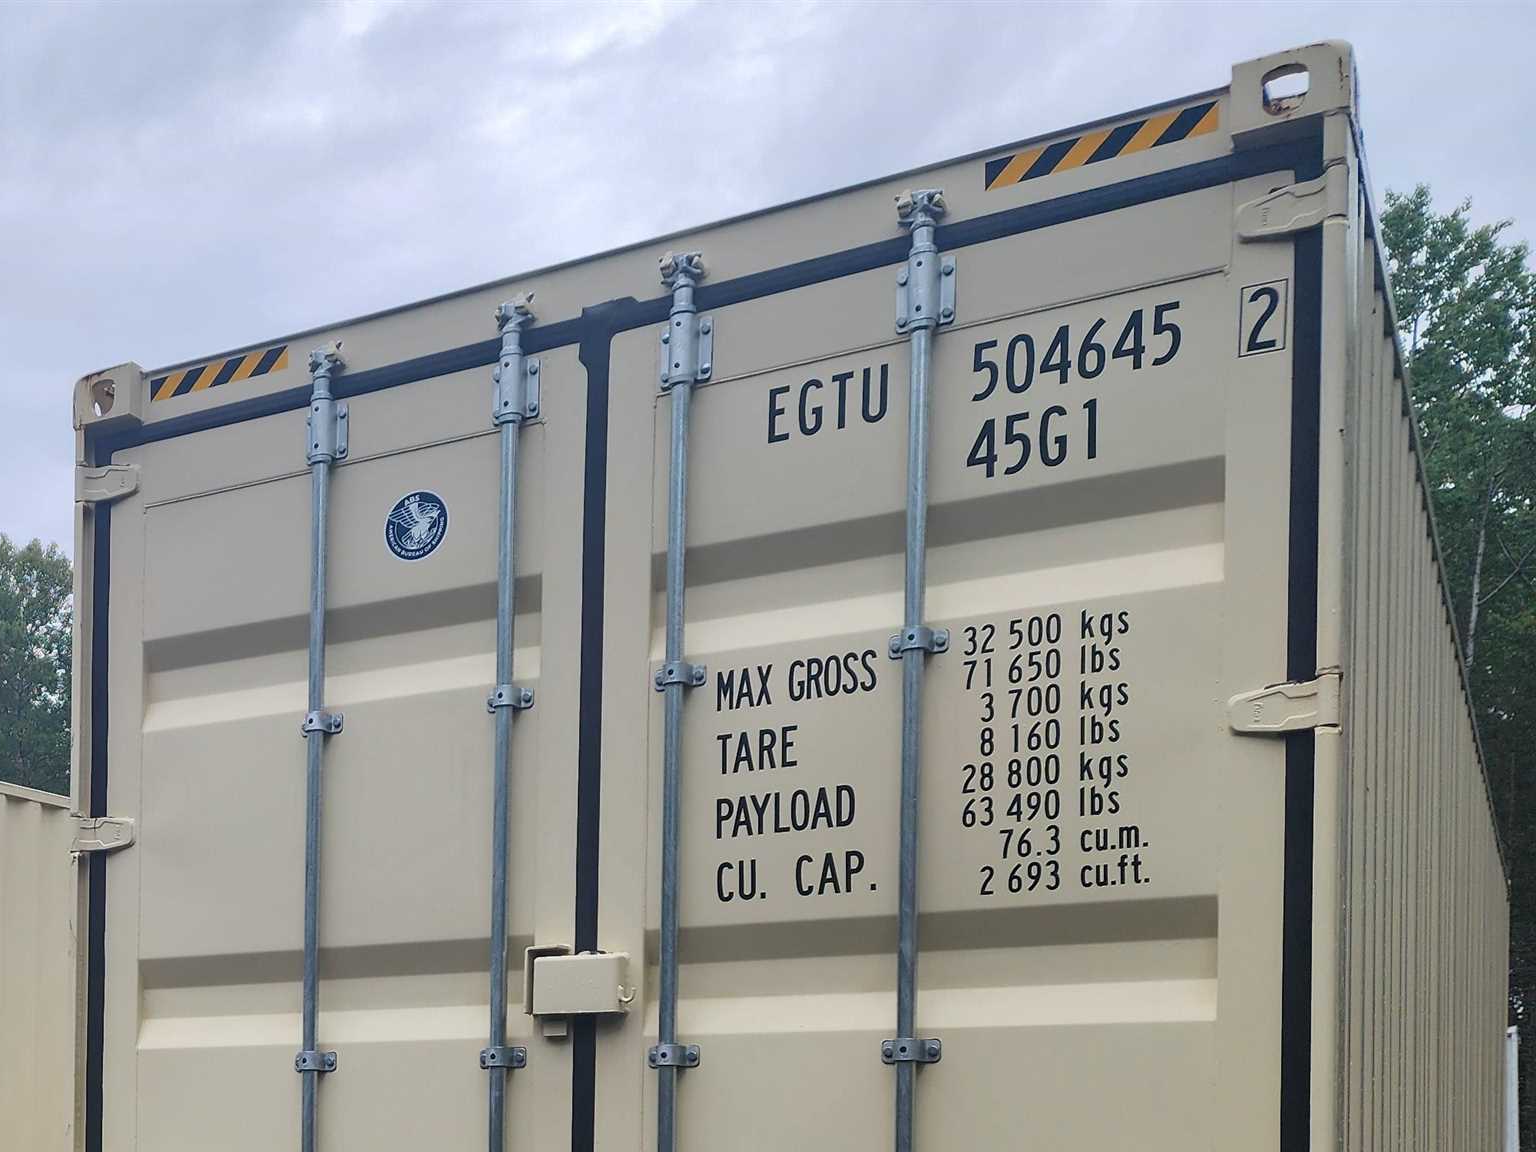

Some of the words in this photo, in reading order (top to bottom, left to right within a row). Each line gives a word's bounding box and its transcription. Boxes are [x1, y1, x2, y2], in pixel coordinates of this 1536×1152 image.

[767, 363, 890, 445] EGTU
[971, 300, 1182, 402] 504645
[1246, 286, 1280, 353] 2
[966, 397, 1099, 479] 45G1
[963, 623, 996, 657] 32
[1008, 613, 1062, 650] 500
[1081, 609, 1130, 646] kgs
[716, 663, 774, 712] MAX
[788, 649, 878, 703] GROSS
[963, 657, 993, 691] 71
[1008, 648, 1062, 684] 650
[1080, 643, 1121, 675] lbs
[980, 692, 996, 723] 3
[1008, 683, 1061, 719] 700
[1080, 680, 1129, 718] kgs
[716, 725, 798, 775] TARE
[980, 727, 995, 757] 8
[1011, 718, 1061, 753] 160
[1079, 714, 1120, 746] lbs
[962, 761, 995, 794] 28
[1007, 753, 1061, 789] 800
[1079, 751, 1129, 789] kgs
[716, 784, 856, 840] PAYLOAD
[961, 796, 994, 828] 63
[1006, 789, 1061, 823] 490
[1079, 785, 1120, 817] lbs
[999, 824, 1061, 860] 76.3
[1080, 825, 1149, 853] cu.m.
[716, 858, 767, 903] CU.
[795, 850, 878, 897] CAP.
[979, 865, 995, 896] 2
[1007, 859, 1061, 894] 693
[1080, 853, 1150, 888] cu.ft.
